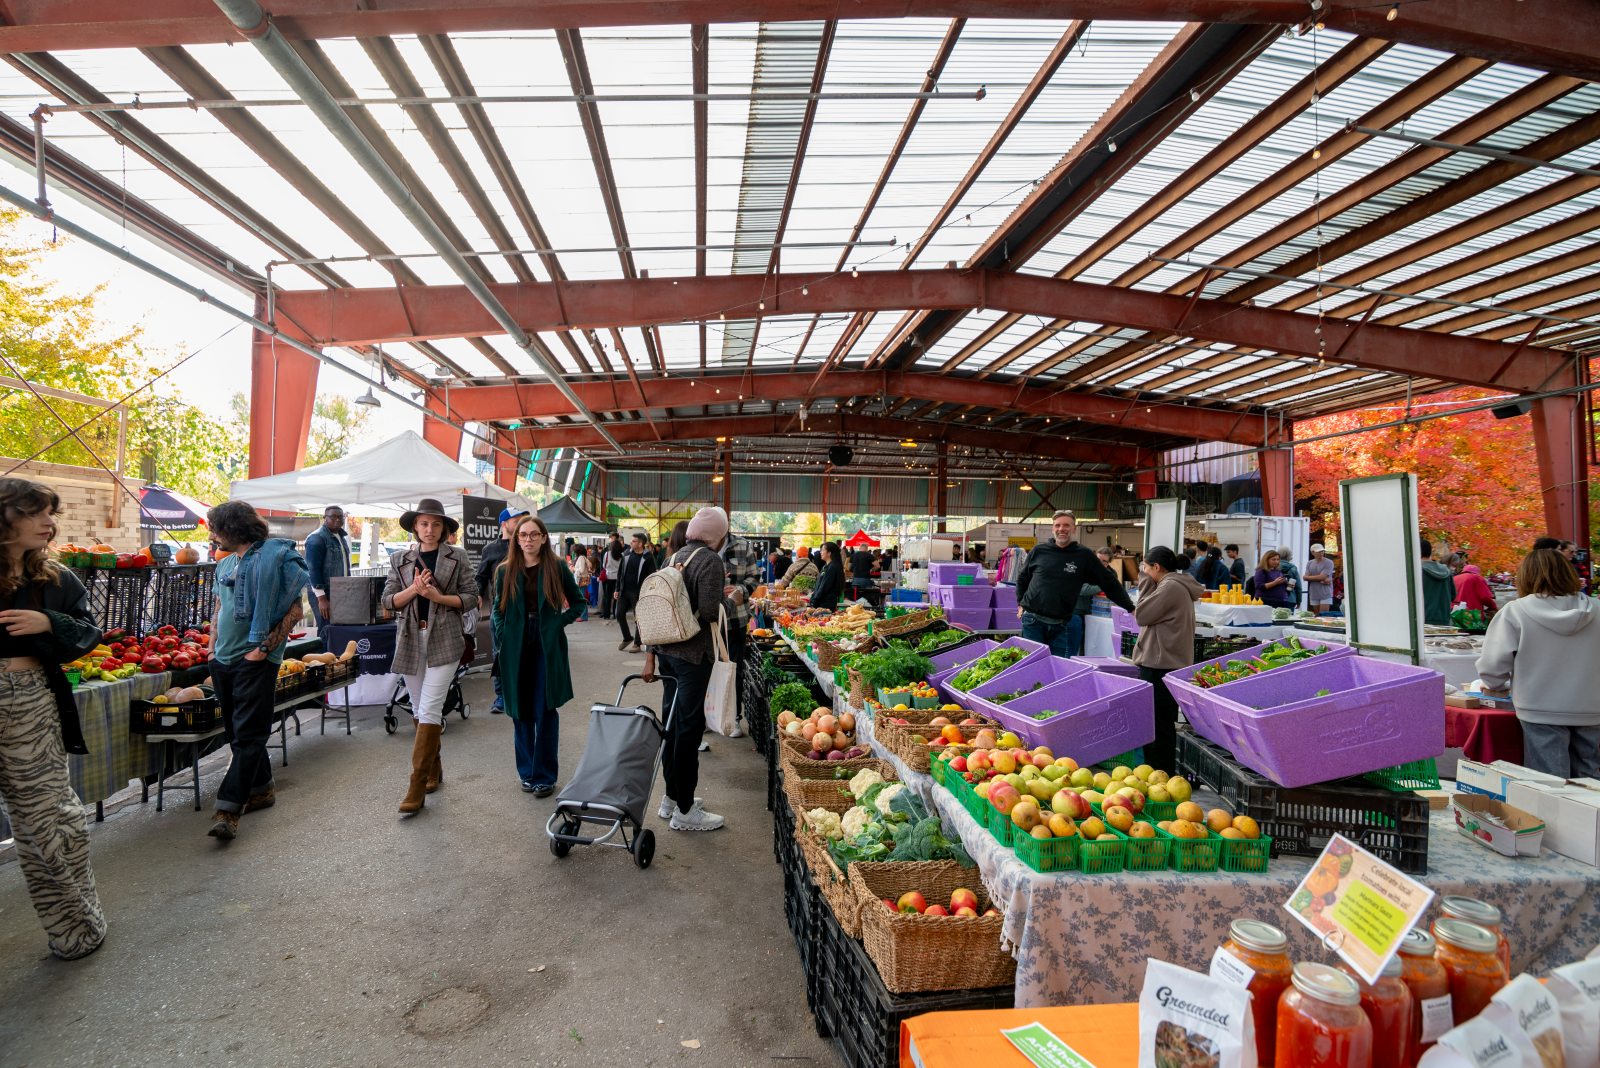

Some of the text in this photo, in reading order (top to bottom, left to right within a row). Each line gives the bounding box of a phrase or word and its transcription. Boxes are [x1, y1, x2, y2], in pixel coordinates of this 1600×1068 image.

[1361, 873, 1387, 895] tomatoes
[1387, 892, 1400, 904] with
[1371, 865, 1413, 896] Celebrate local
[1360, 892, 1393, 919] Marinara Sauce
[1156, 986, 1230, 1026] Grounded
